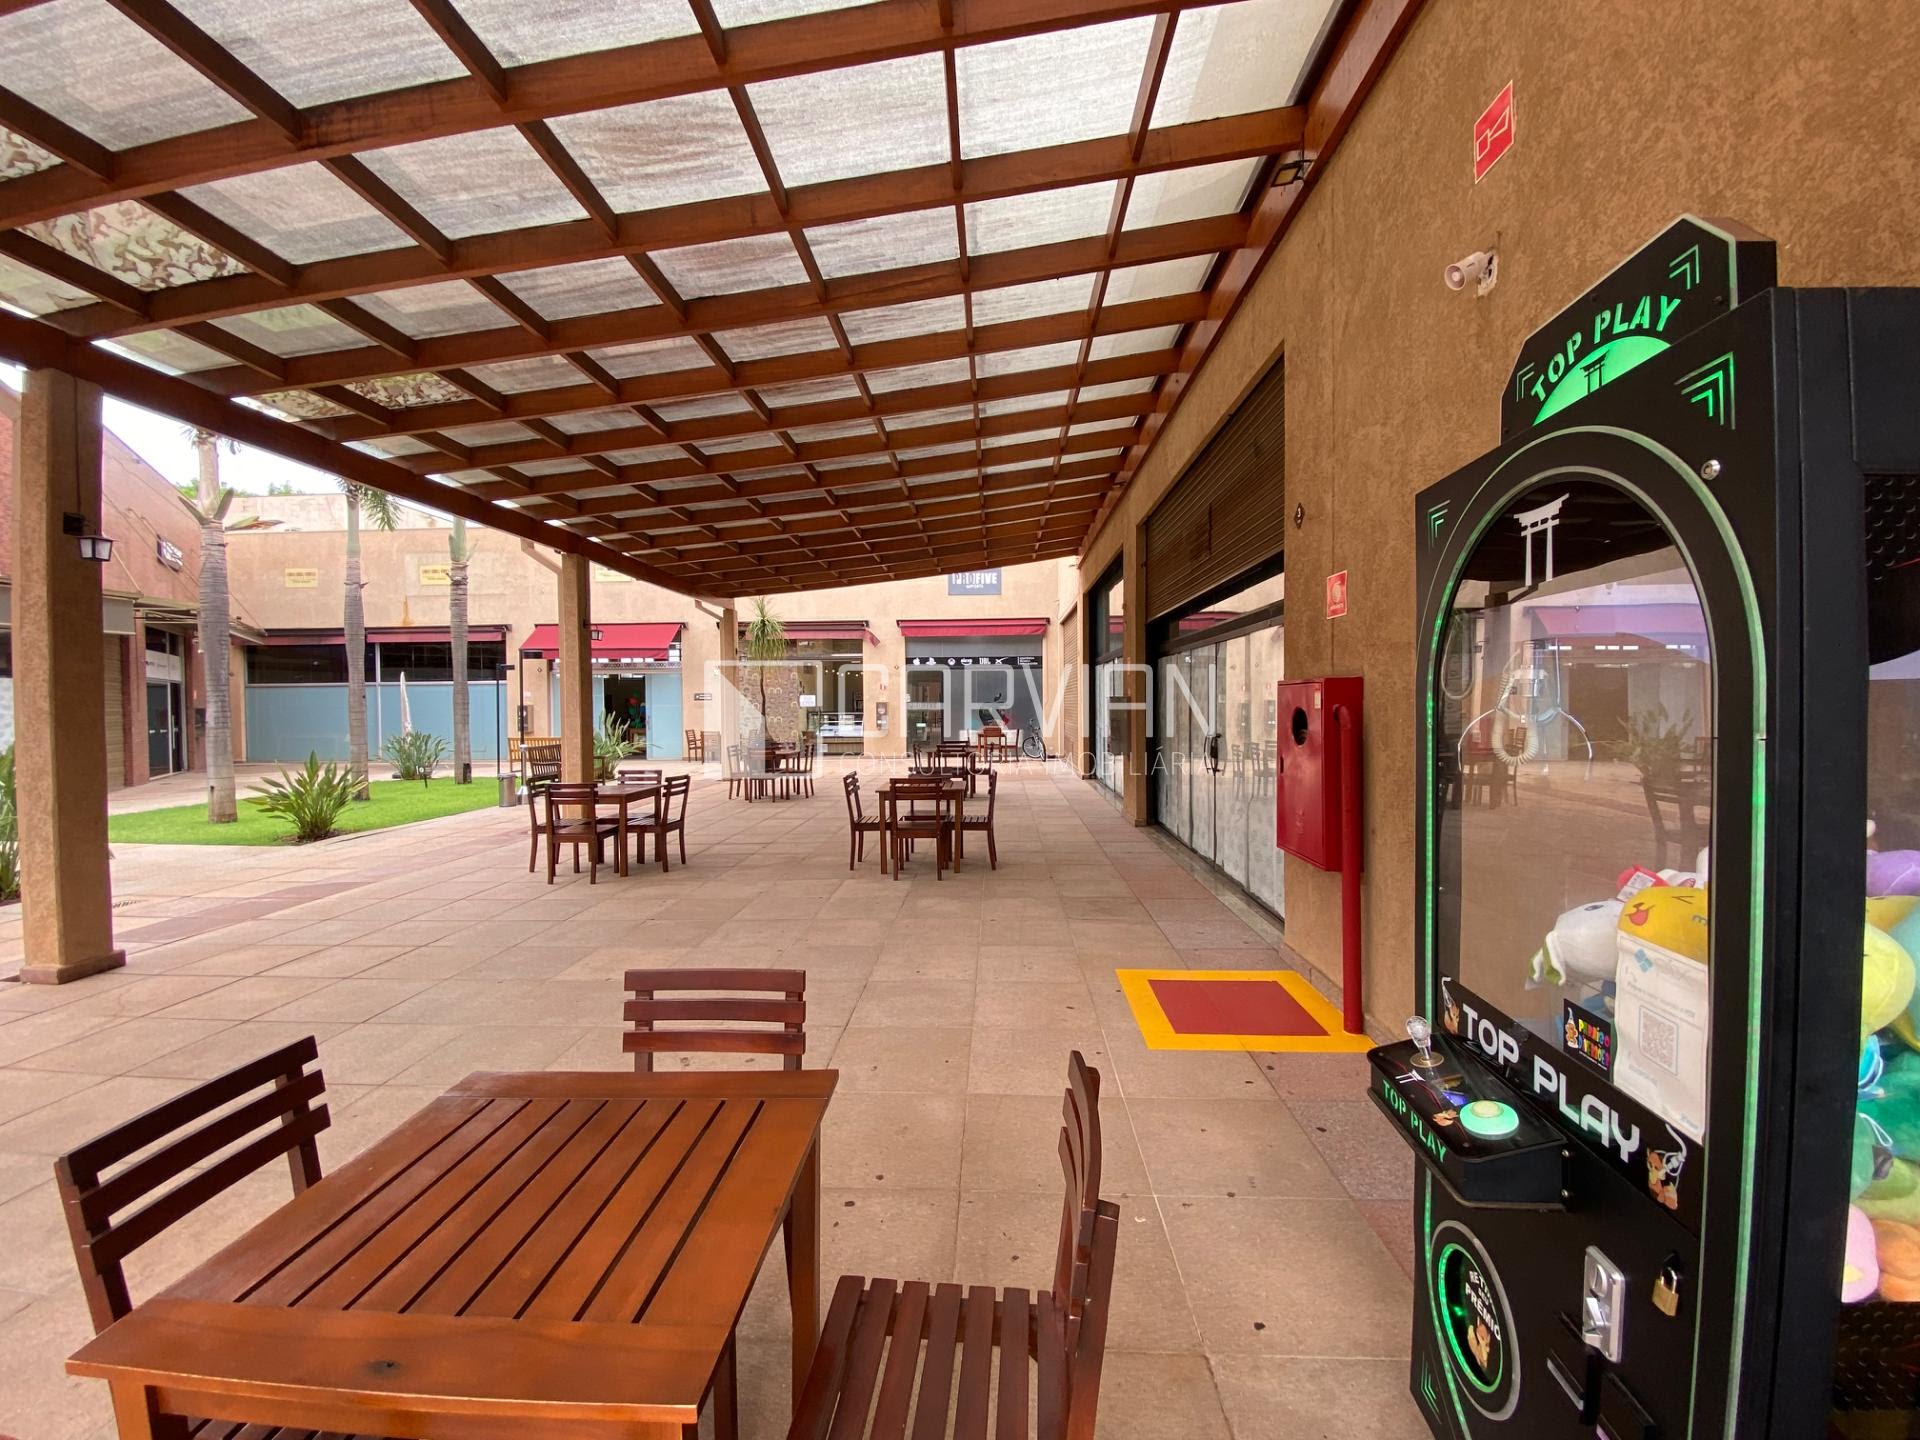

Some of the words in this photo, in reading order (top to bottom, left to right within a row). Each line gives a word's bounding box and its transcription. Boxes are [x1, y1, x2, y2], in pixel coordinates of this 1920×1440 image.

[1530, 331, 1582, 402] TOP
[1594, 295, 1681, 345] PLAY
[1382, 1079, 1407, 1115] TOP
[1410, 1110, 1447, 1164] PLAY
[1462, 1002, 1520, 1066] TOP
[1533, 1054, 1640, 1164] PLAY
